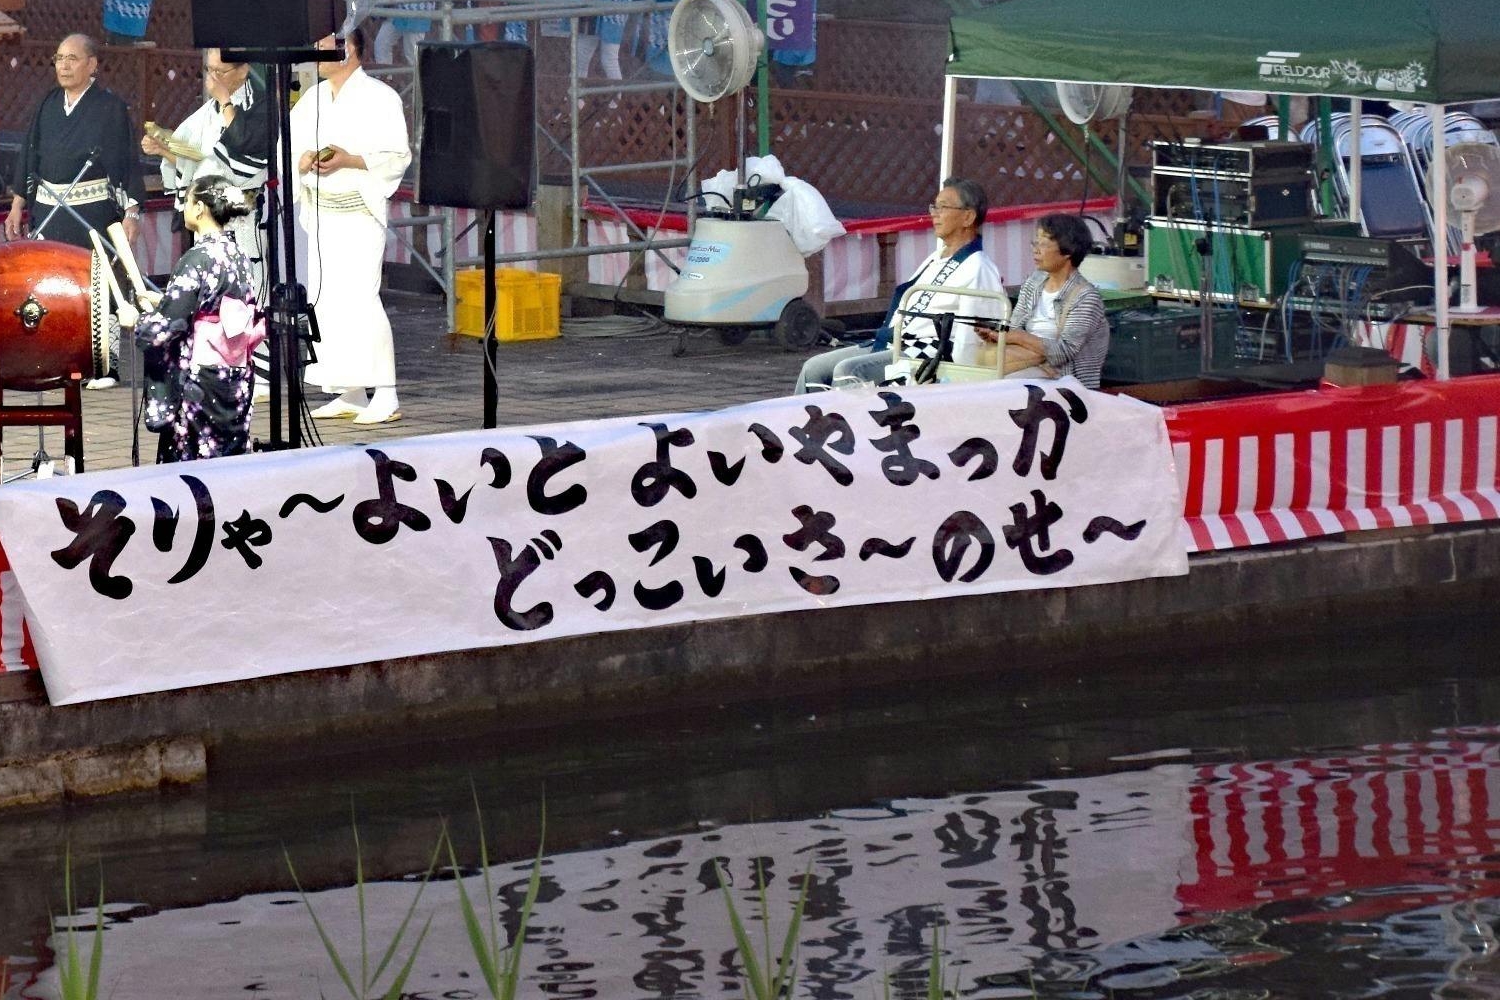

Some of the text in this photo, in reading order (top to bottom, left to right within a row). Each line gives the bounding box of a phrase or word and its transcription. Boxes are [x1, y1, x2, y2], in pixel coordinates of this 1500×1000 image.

[628, 384, 1088, 508] よいやまっか
